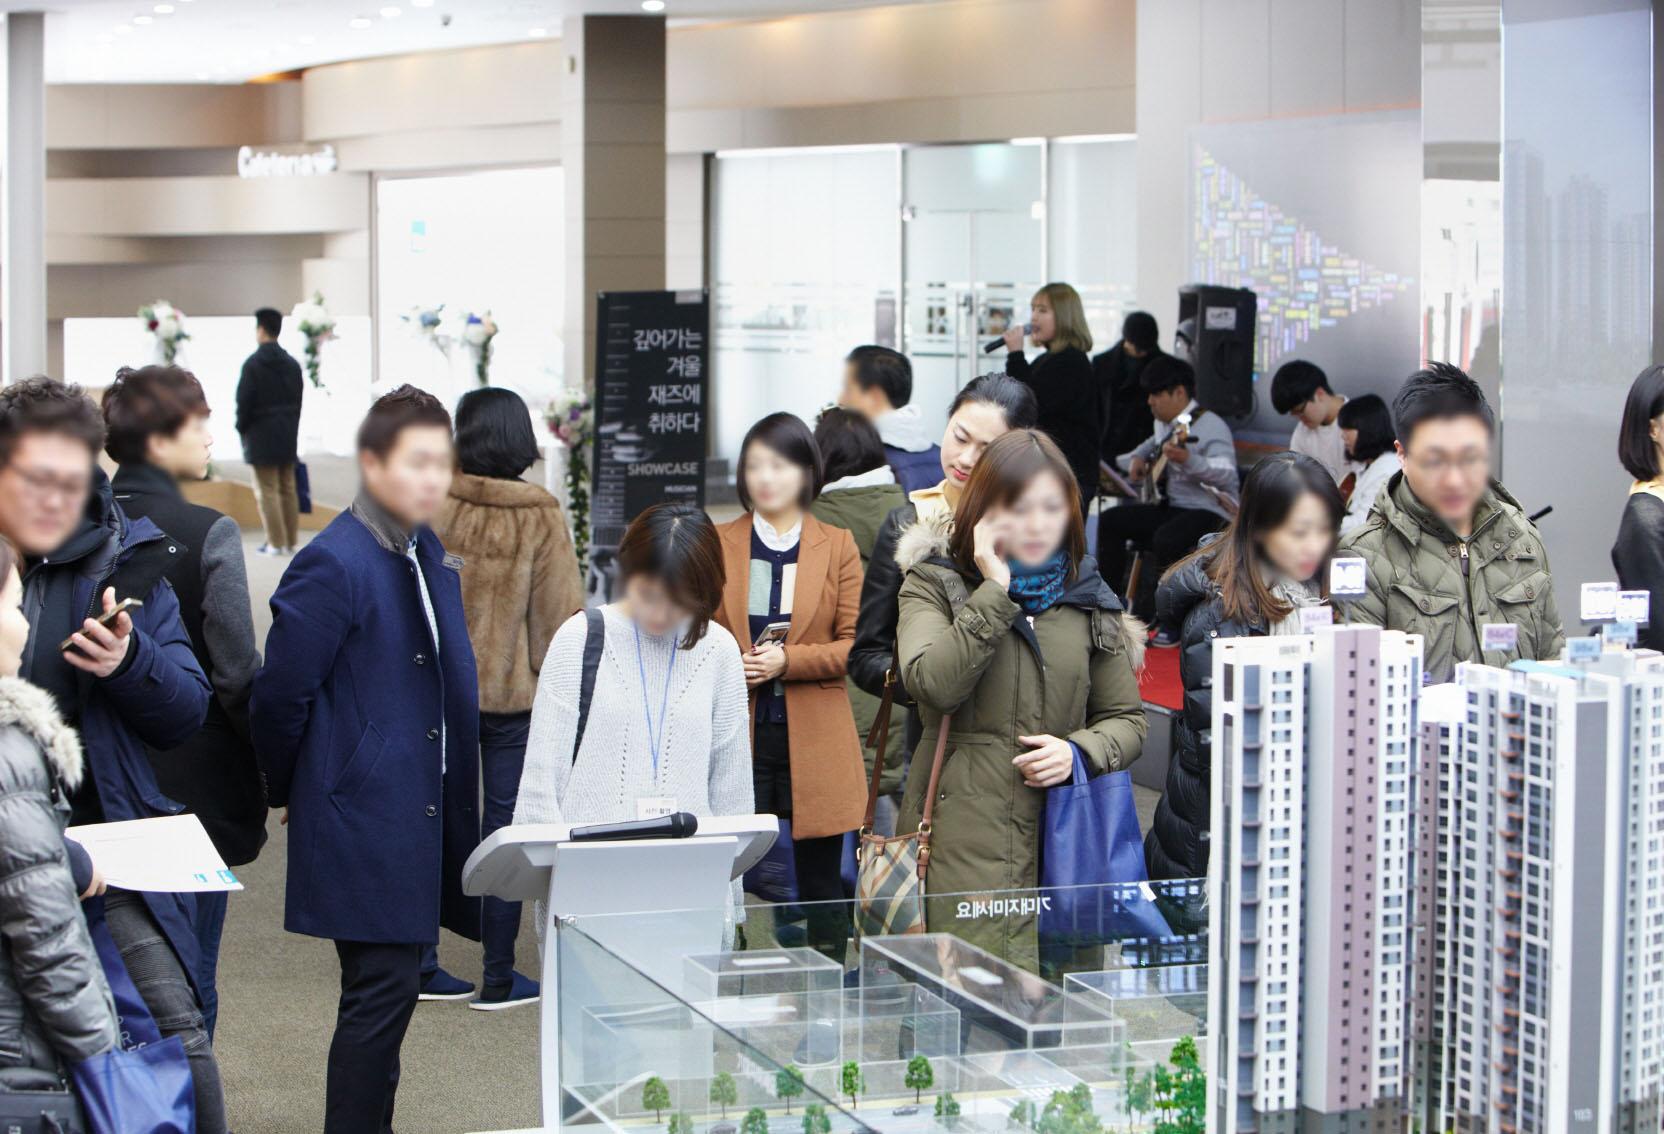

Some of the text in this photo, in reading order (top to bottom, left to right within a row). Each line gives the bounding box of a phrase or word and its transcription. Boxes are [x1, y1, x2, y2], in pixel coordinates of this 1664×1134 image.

[633, 328, 702, 351] 깊어가는
[666, 354, 702, 378] 겨울
[647, 384, 701, 405] 재즈에
[647, 412, 701, 434] 취하다
[627, 462, 699, 476] SHOWCASE
